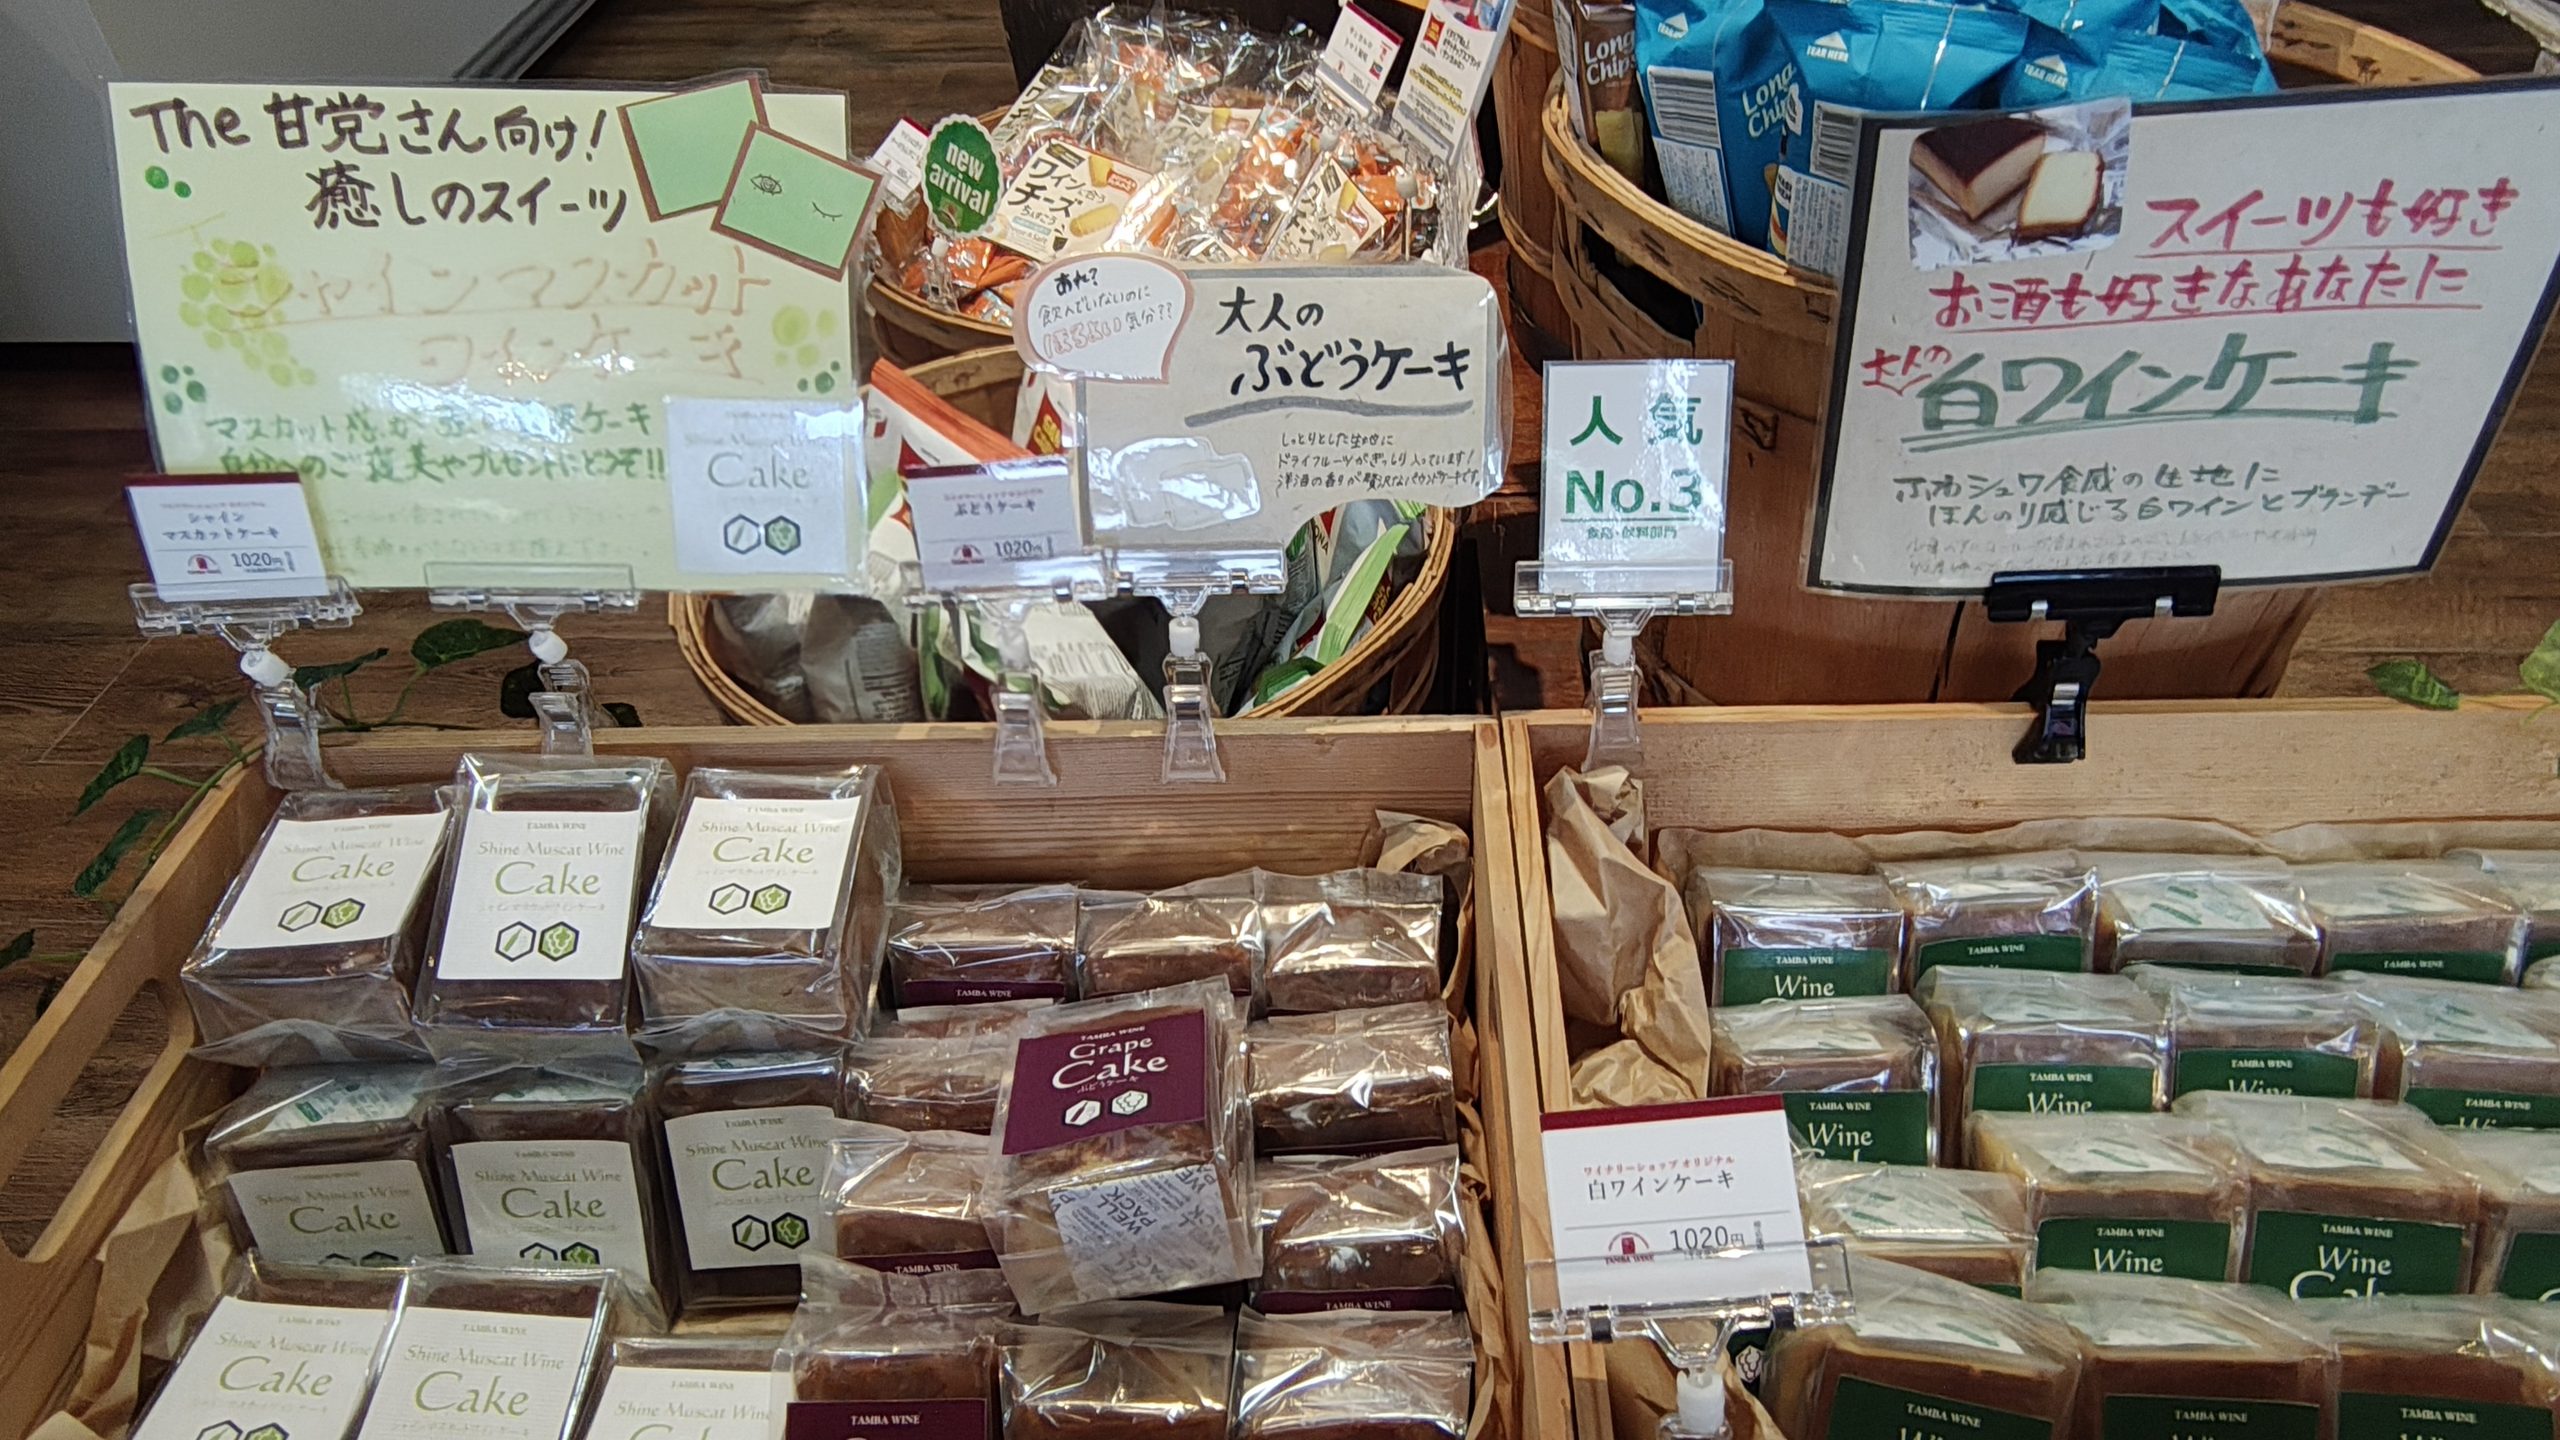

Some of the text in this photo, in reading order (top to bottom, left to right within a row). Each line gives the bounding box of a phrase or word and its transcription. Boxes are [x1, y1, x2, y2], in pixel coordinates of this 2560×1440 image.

[129, 97, 251, 154] The
[945, 142, 984, 182] new
[306, 160, 628, 233] 癒しのスイーツ
[929, 162, 991, 217] arrival
[2146, 177, 2520, 251] スイーツも好き
[1928, 249, 2469, 326] お酒も好きなあなたに
[1216, 286, 1324, 336] 大人の
[1230, 338, 1472, 396] ぶどうケーキ
[1916, 332, 2419, 431] 白ワインケーキ
[708, 451, 811, 490] Cake
[1565, 468, 1704, 515] No.3
[162, 526, 280, 542] マスカットケーキ
[698, 821, 841, 835] Shine Muscat Wine
[478, 841, 625, 856] Shine Muscat Wine
[712, 835, 815, 865] Cake
[291, 853, 396, 884] Cake
[494, 860, 602, 896] Cake
[1775, 955, 1834, 966] TAMBA WINE
[1968, 943, 2026, 956] TAMBA WINE
[2383, 959, 2445, 970] TAMBA WINE
[956, 988, 1013, 999] TAMBA WINE
[1773, 974, 1836, 998] Wine
[1080, 1025, 1147, 1042] TAMBA WINE
[1069, 1035, 1154, 1061] Grape
[1052, 1053, 1169, 1091] Cake
[2231, 1058, 2294, 1070] TAMBA WINE
[2029, 1072, 2094, 1083] TAMBA WINE
[1809, 1101, 1872, 1112] TAMBA WINE
[2026, 1091, 2093, 1116] Wine
[2465, 1098, 2532, 1112] TAMBA WINE
[686, 1135, 830, 1157] Shine Muscat Wine
[1807, 1122, 1874, 1148] Wine
[474, 1168, 623, 1184] Shine Muscat Wine
[711, 1156, 816, 1192] Cake
[1583, 1155, 1736, 1177] ワイナリーショップ オリジナル
[1588, 1169, 1735, 1201] 白ワインケーキ
[501, 1187, 607, 1220] Cake
[1098, 1194, 1143, 1236] WELL
[1107, 1185, 1158, 1228] PACK
[289, 1203, 401, 1236] Cake
[2097, 1226, 2165, 1239] TAMBA WINE
[2322, 1223, 2394, 1239] TAMBA WINE
[894, 1263, 961, 1275] TAMBA WINE
[2092, 1248, 2164, 1274] Wine
[2316, 1244, 2393, 1276] Wine
[1325, 1300, 1393, 1311] TAMBA WINE
[403, 1344, 565, 1371] Shine Muscat Wine
[219, 1354, 333, 1397] Cake
[415, 1370, 530, 1417] Cake
[613, 1400, 662, 1418] Shine
[665, 1402, 727, 1419] Muscat
[850, 1414, 921, 1427] TAMBA WINE
[1907, 1403, 1983, 1429] TAMBA WINE
[2174, 1409, 2248, 1424] TAMBA WINE
[2401, 1407, 2478, 1425] TAMBA WINE
